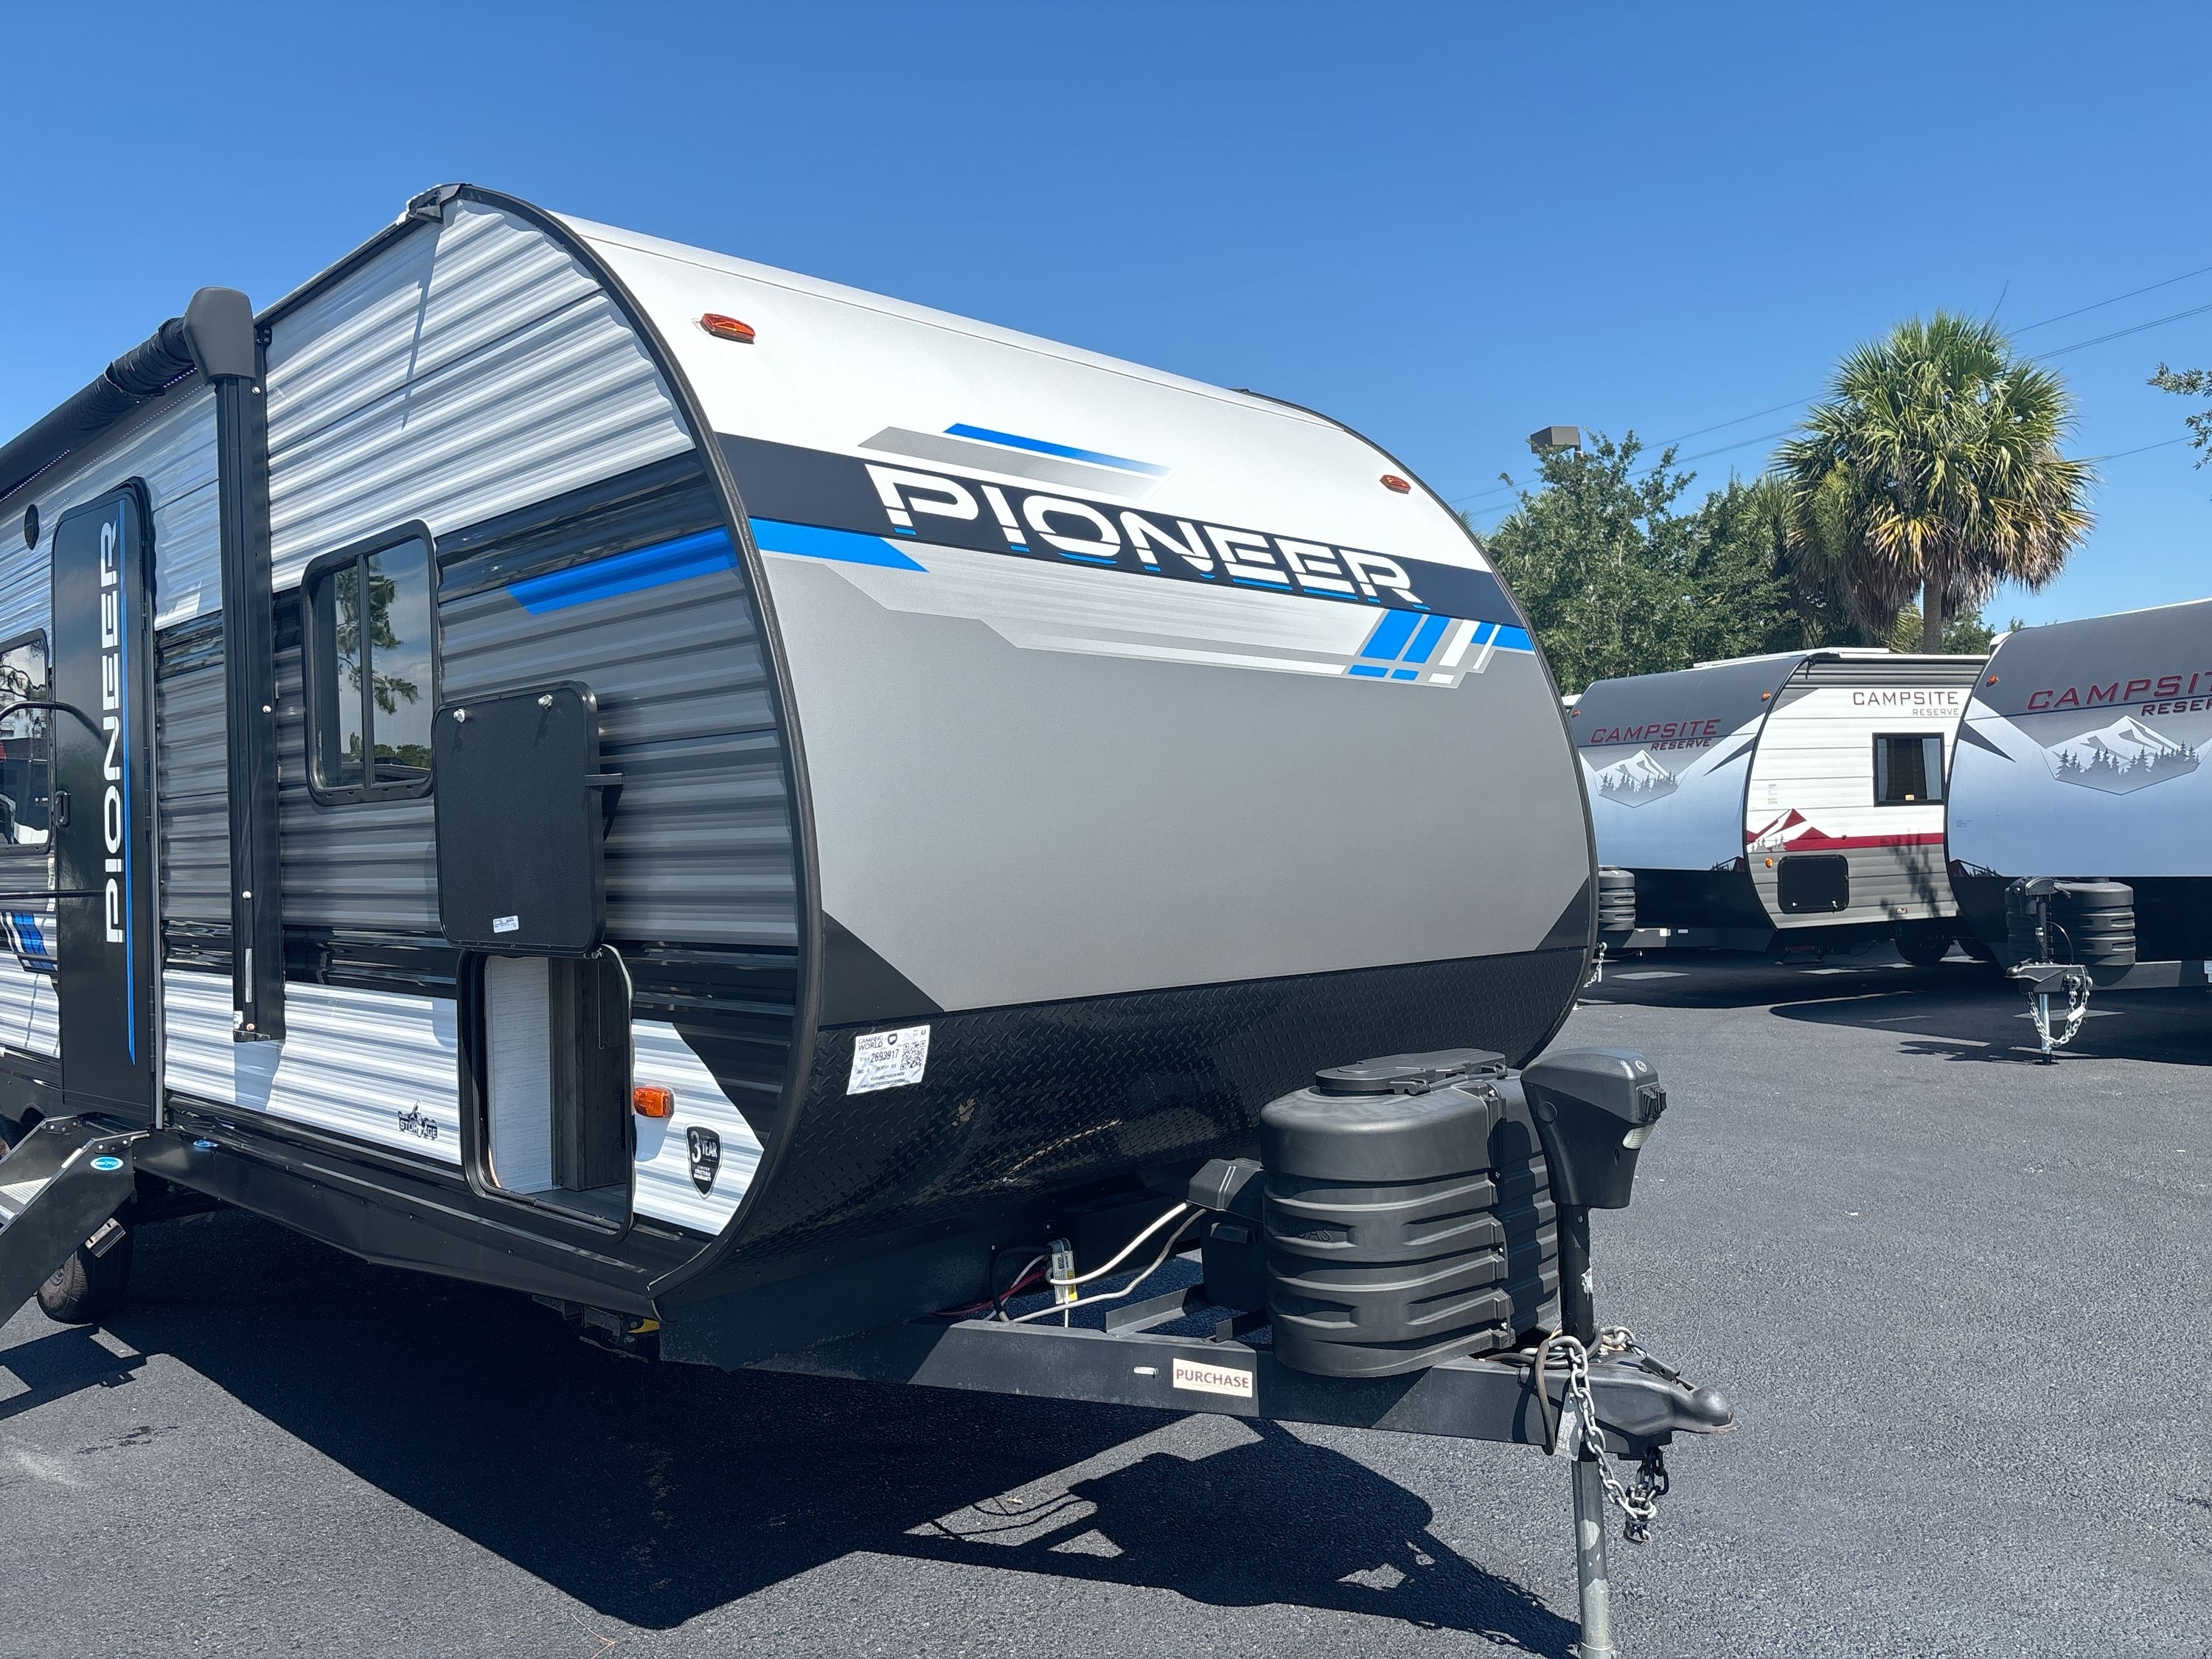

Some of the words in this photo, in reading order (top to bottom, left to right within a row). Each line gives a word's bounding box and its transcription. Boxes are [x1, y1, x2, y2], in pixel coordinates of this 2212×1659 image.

[864, 463, 1430, 611] PIONEER
[1853, 692, 1959, 706] CAMPSITE
[1913, 708, 1959, 716] RESERVE
[101, 520, 125, 944] PIONEER
[1590, 719, 1722, 744] CAMPSITE
[1651, 738, 1712, 751] RESERVE
[858, 1041, 883, 1051] WORLD
[870, 1048, 900, 1062] 2693917
[690, 1130, 701, 1163] 3
[700, 1139, 717, 1158] YEAR
[1176, 1368, 1249, 1388] PURCHASE
